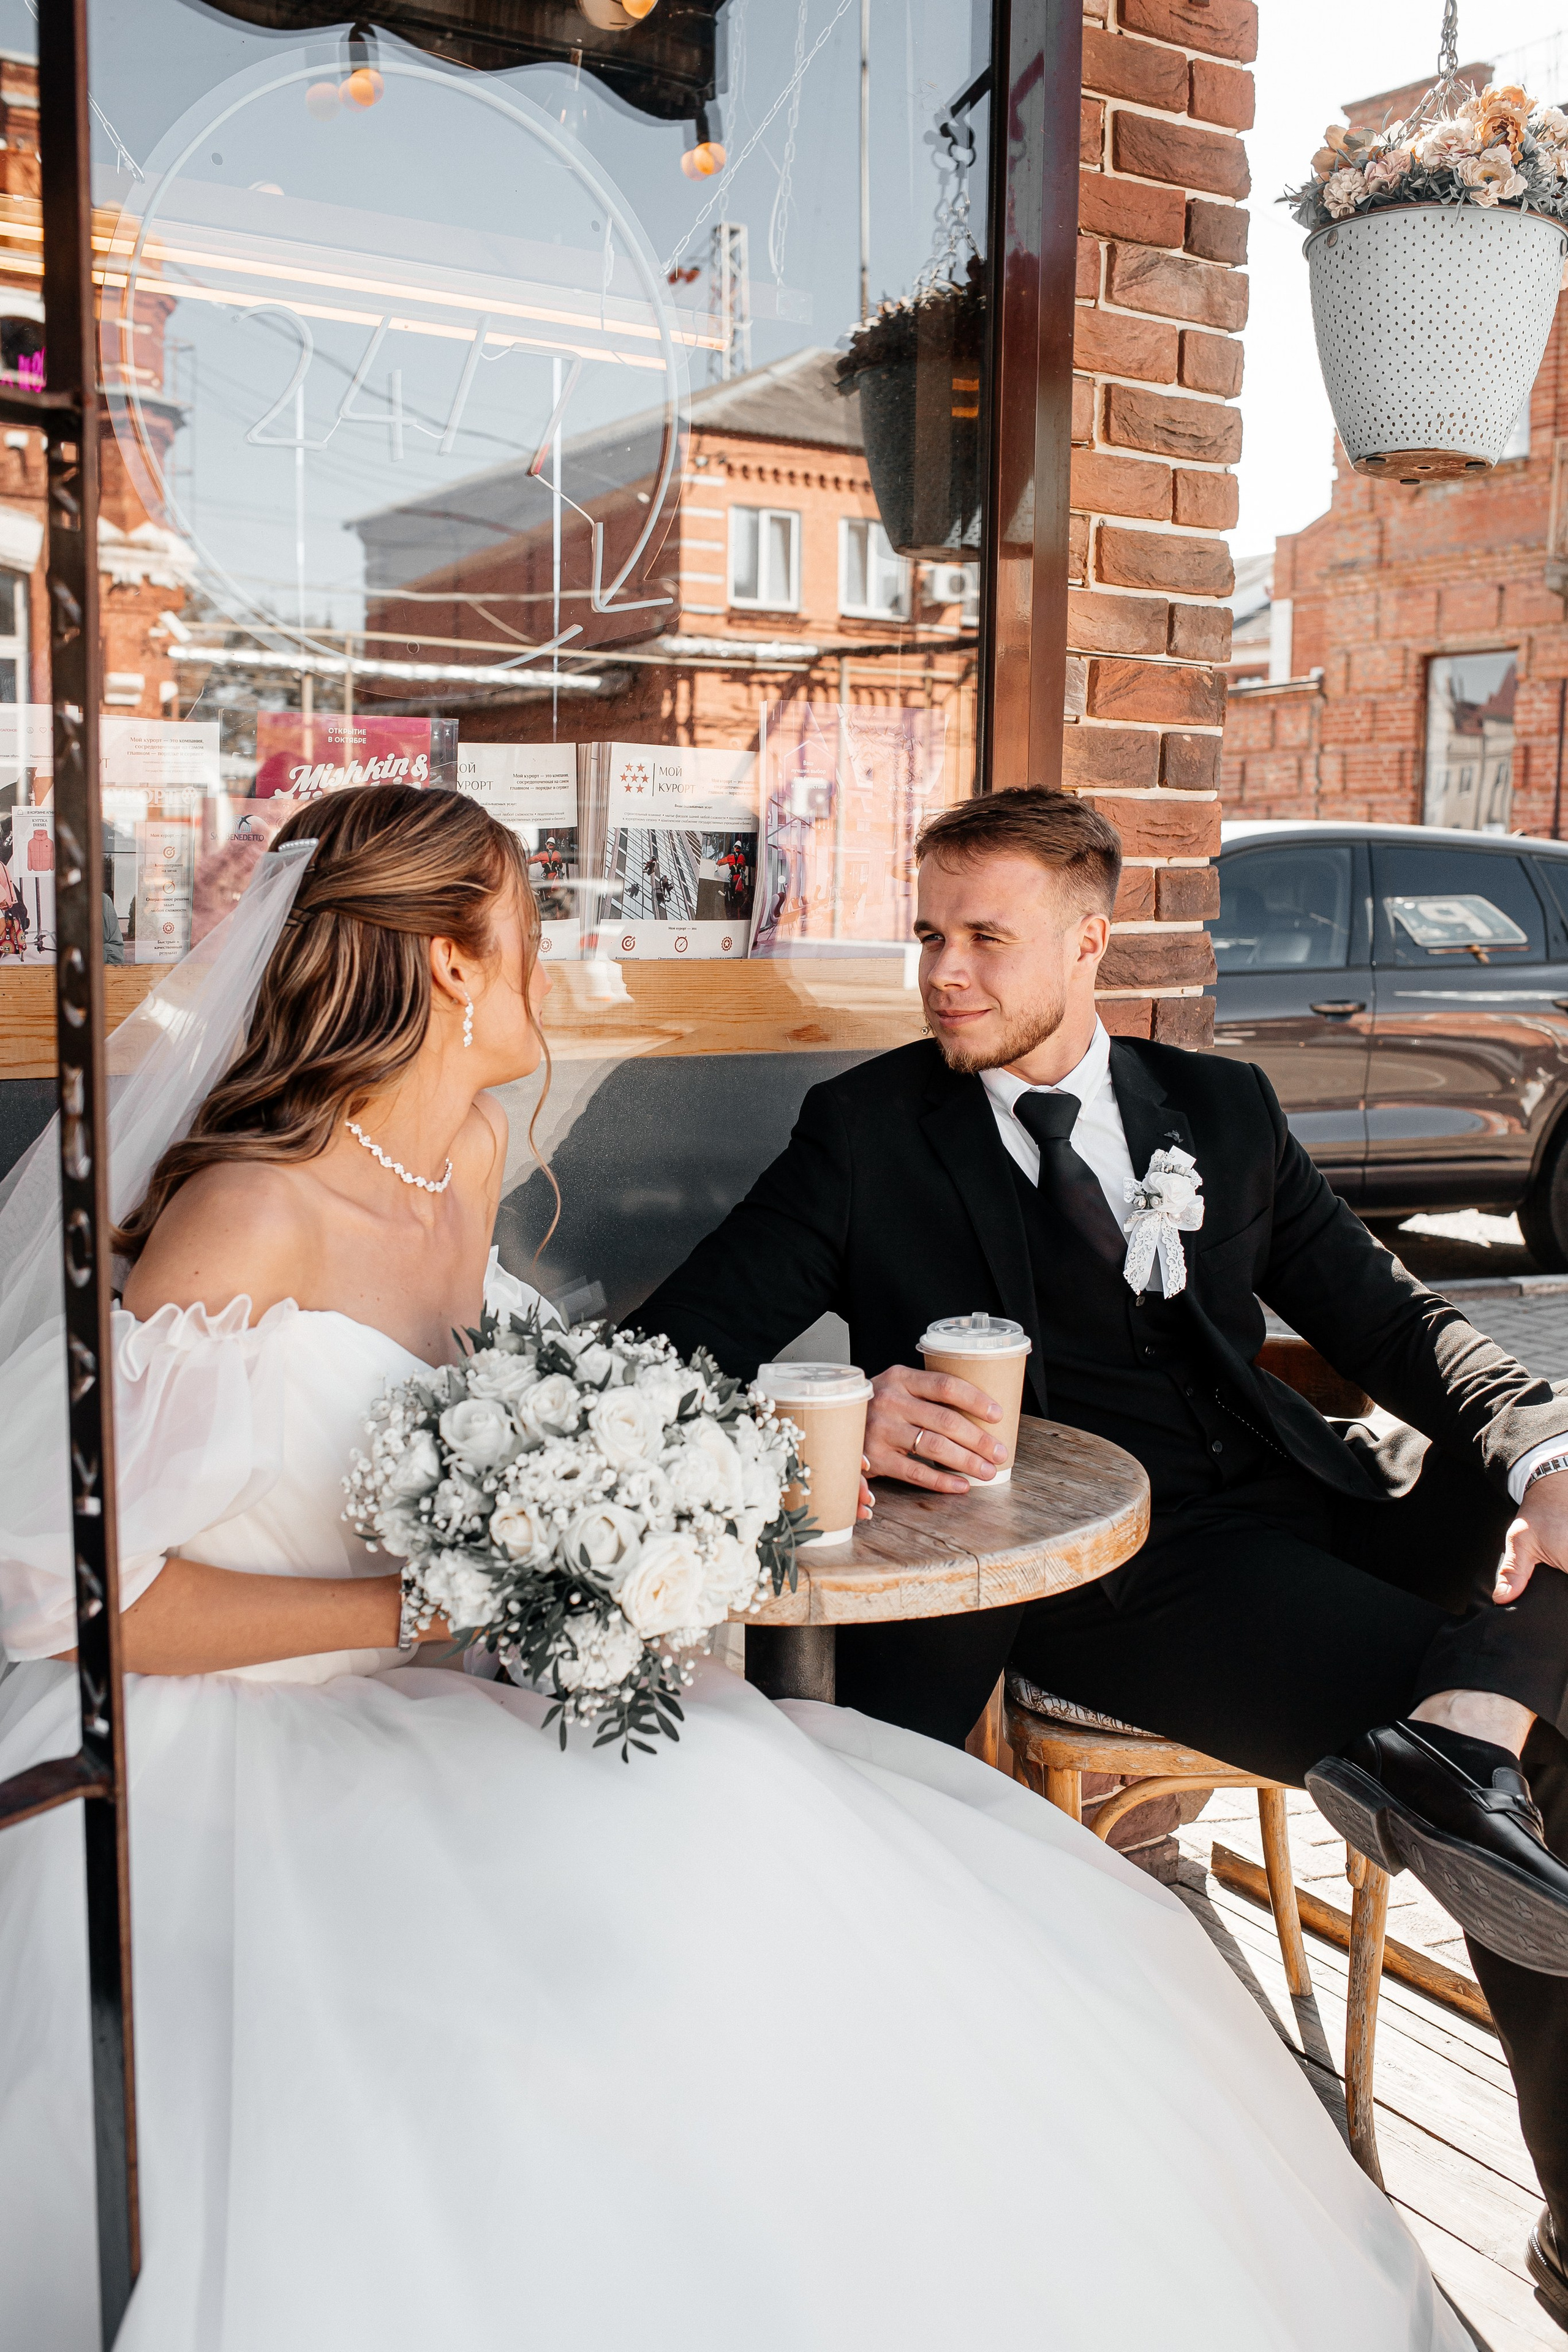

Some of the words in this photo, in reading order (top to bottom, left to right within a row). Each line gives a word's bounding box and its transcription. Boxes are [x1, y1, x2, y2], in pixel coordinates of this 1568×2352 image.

[232, 303, 583, 477] 24/7
[457, 762, 476, 773] ОЙ
[659, 766, 682, 777] МОЙ
[274, 753, 410, 796] Mishkin
[411, 754, 429, 782] &
[457, 780, 494, 790] УРОРТ
[658, 783, 696, 794] КУРОРТ
